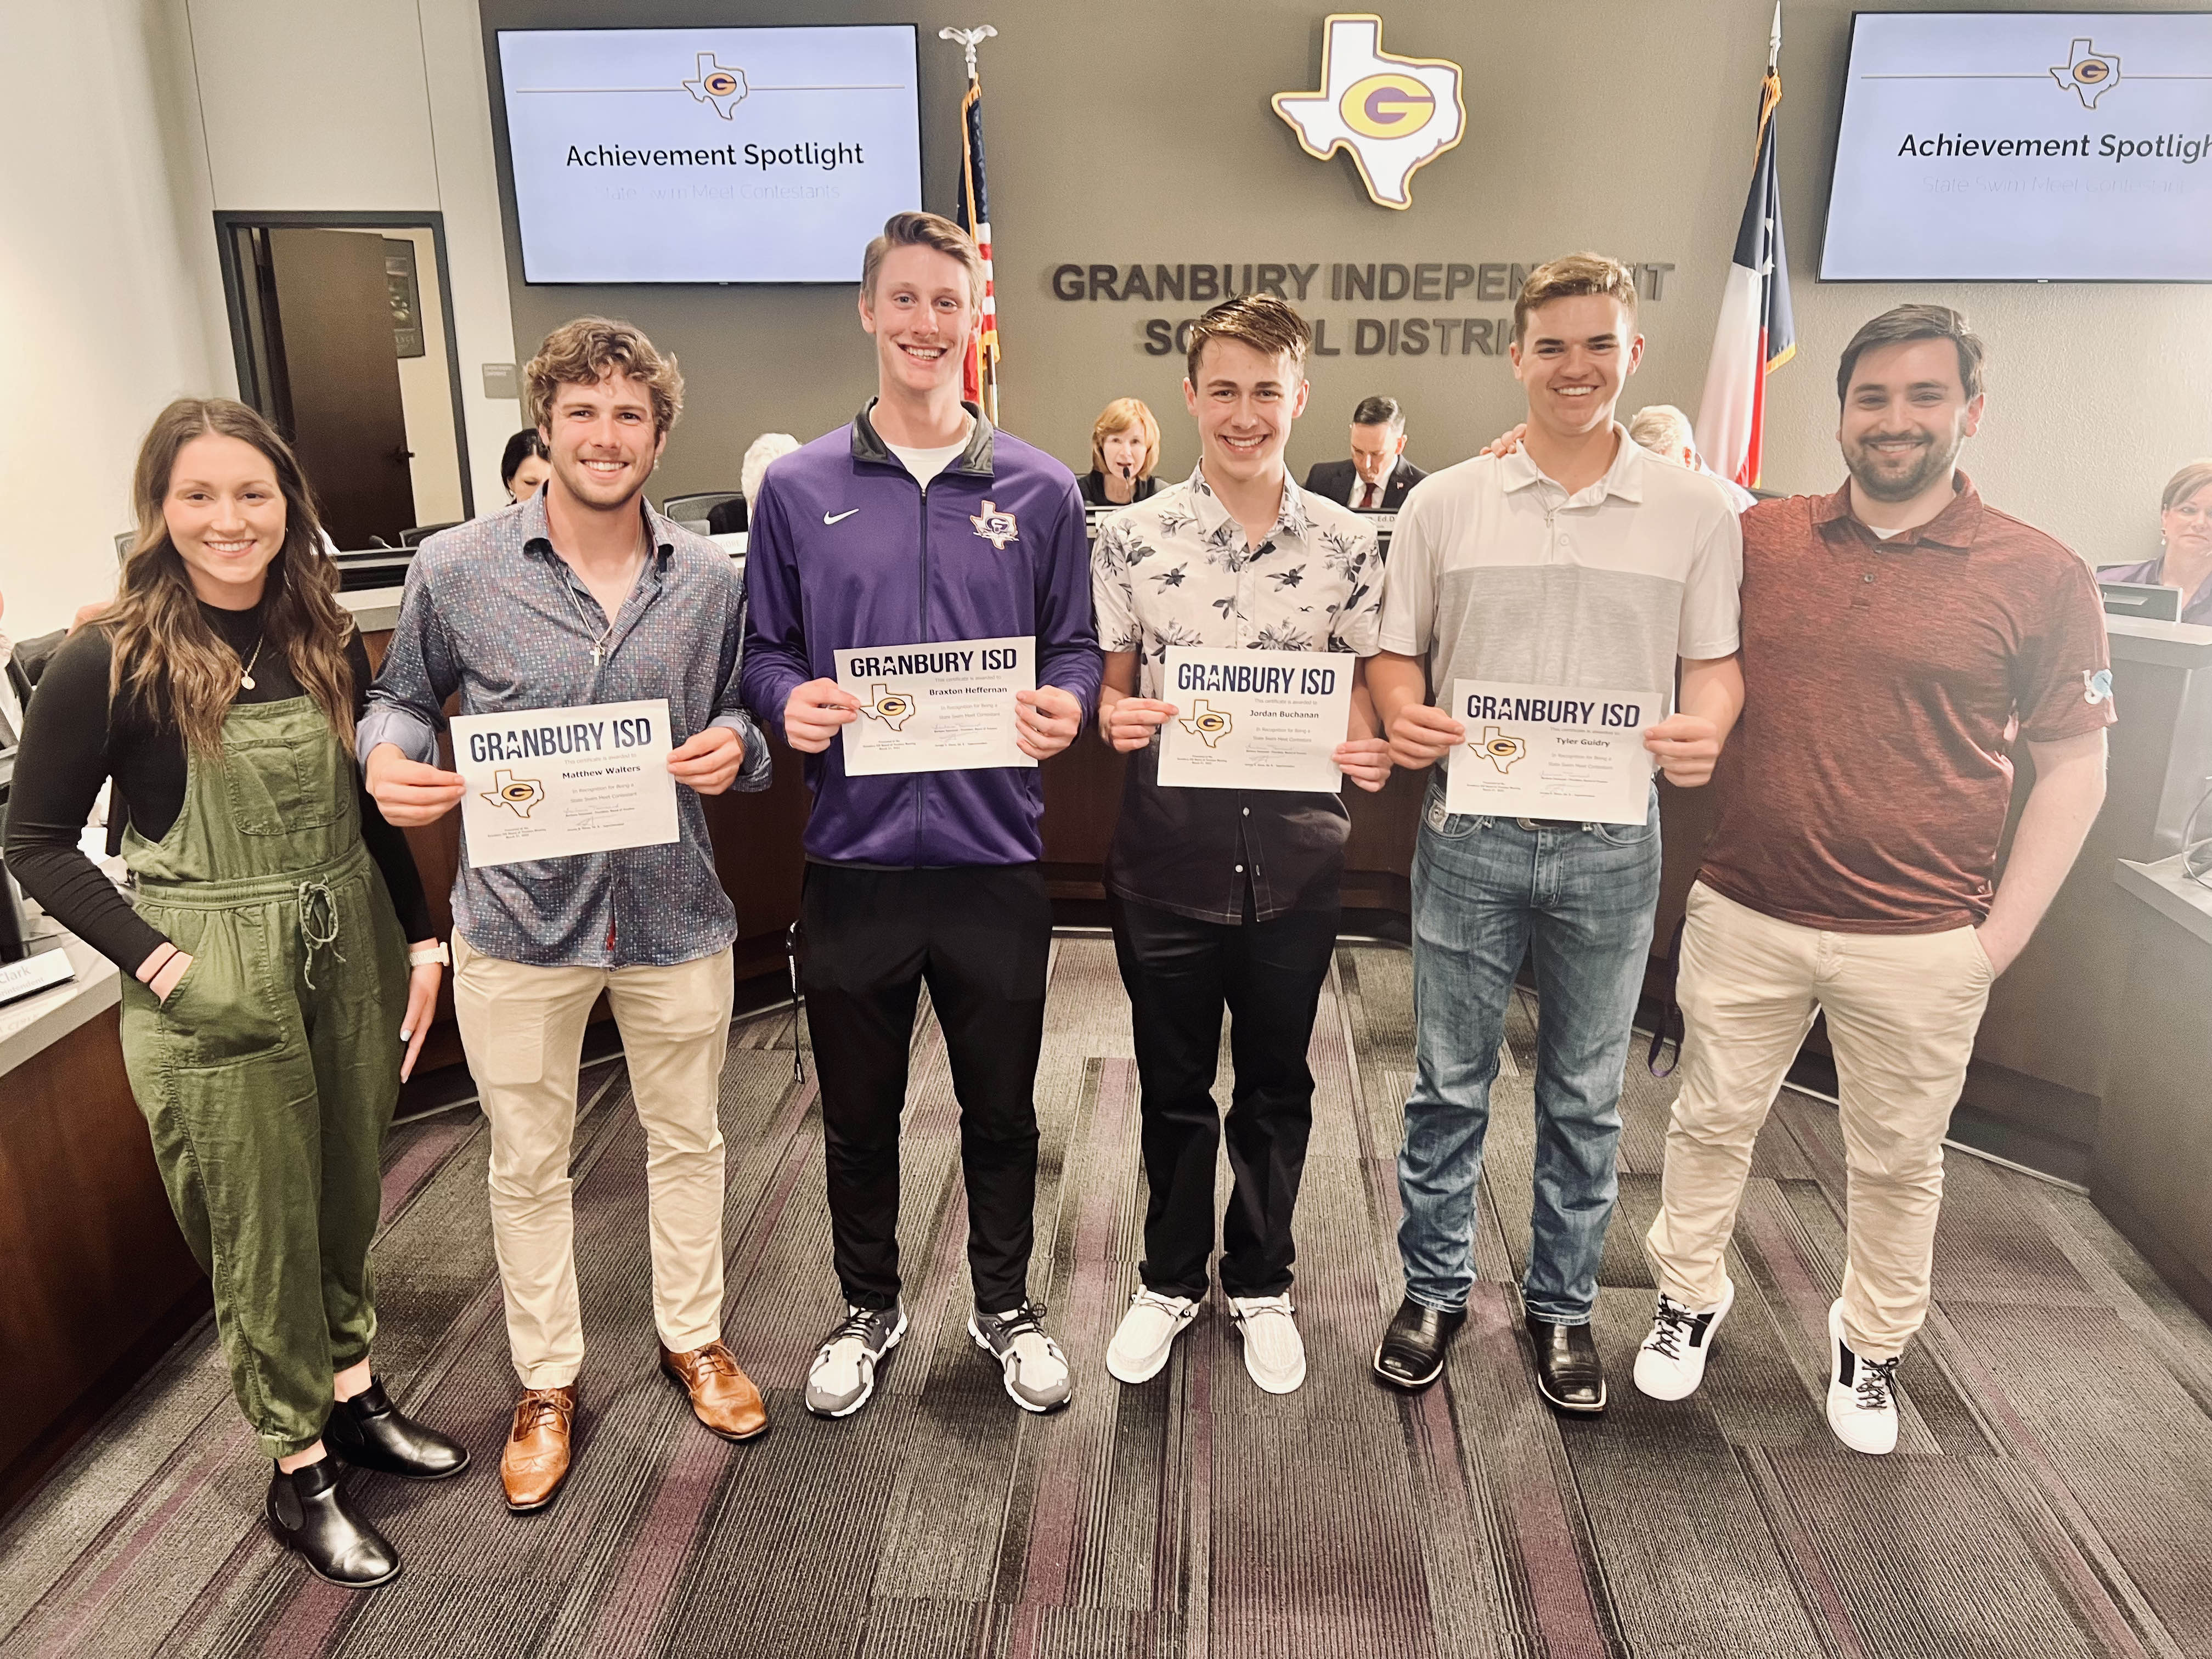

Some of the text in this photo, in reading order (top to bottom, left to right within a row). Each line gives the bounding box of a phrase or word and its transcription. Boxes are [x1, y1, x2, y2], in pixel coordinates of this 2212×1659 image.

[566, 142, 864, 171] Achievement Spotlight
[1897, 133, 2212, 164] Achievement Spotligh
[692, 184, 734, 199] Meet
[740, 183, 840, 200] Contestants
[1052, 263, 1675, 301] GRANBURY INDEPENT
[1355, 318, 1516, 356] DISTRI
[851, 648, 1017, 678] GRANBURY ISD
[1178, 663, 1335, 695] GRANBURY ISD
[1467, 695, 1640, 727] GRANBURY ISD
[470, 718, 651, 762] GRANBURY ISD
[1581, 738, 1610, 748] Guidry
[562, 765, 641, 779] Matthew Walters
